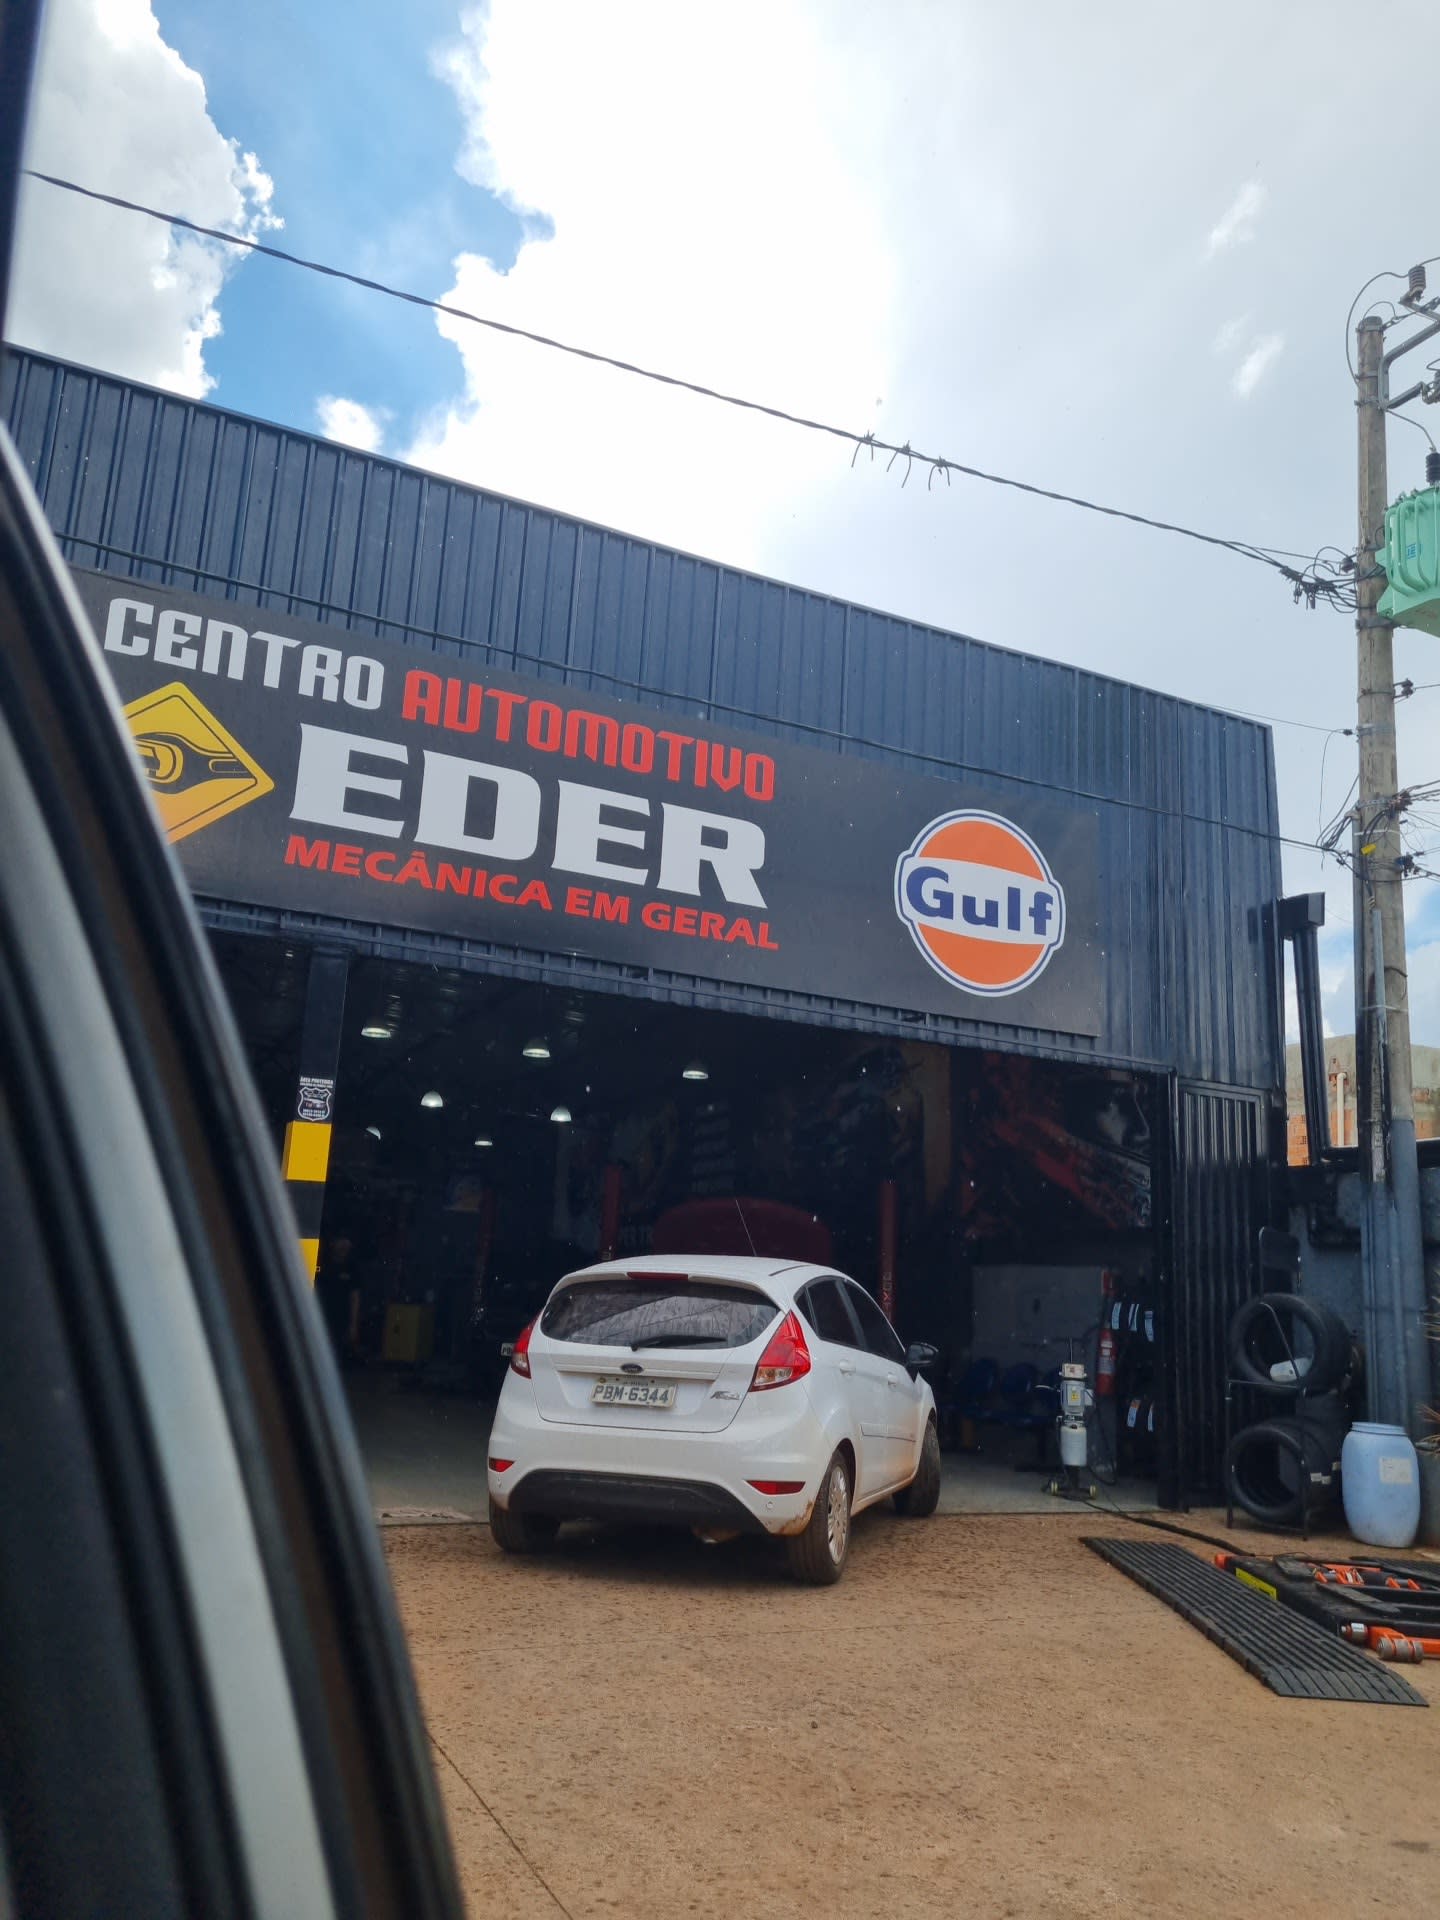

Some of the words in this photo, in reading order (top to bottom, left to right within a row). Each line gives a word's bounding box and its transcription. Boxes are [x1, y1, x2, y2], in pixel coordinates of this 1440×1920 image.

[103, 598, 385, 710] CENTRO
[402, 670, 775, 801] AUTOMOTIVO
[289, 722, 768, 909] EDER
[285, 835, 553, 911] MECÂNICA
[564, 886, 631, 924] EM
[642, 902, 779, 950] GERAL
[906, 866, 1053, 936] Gulf
